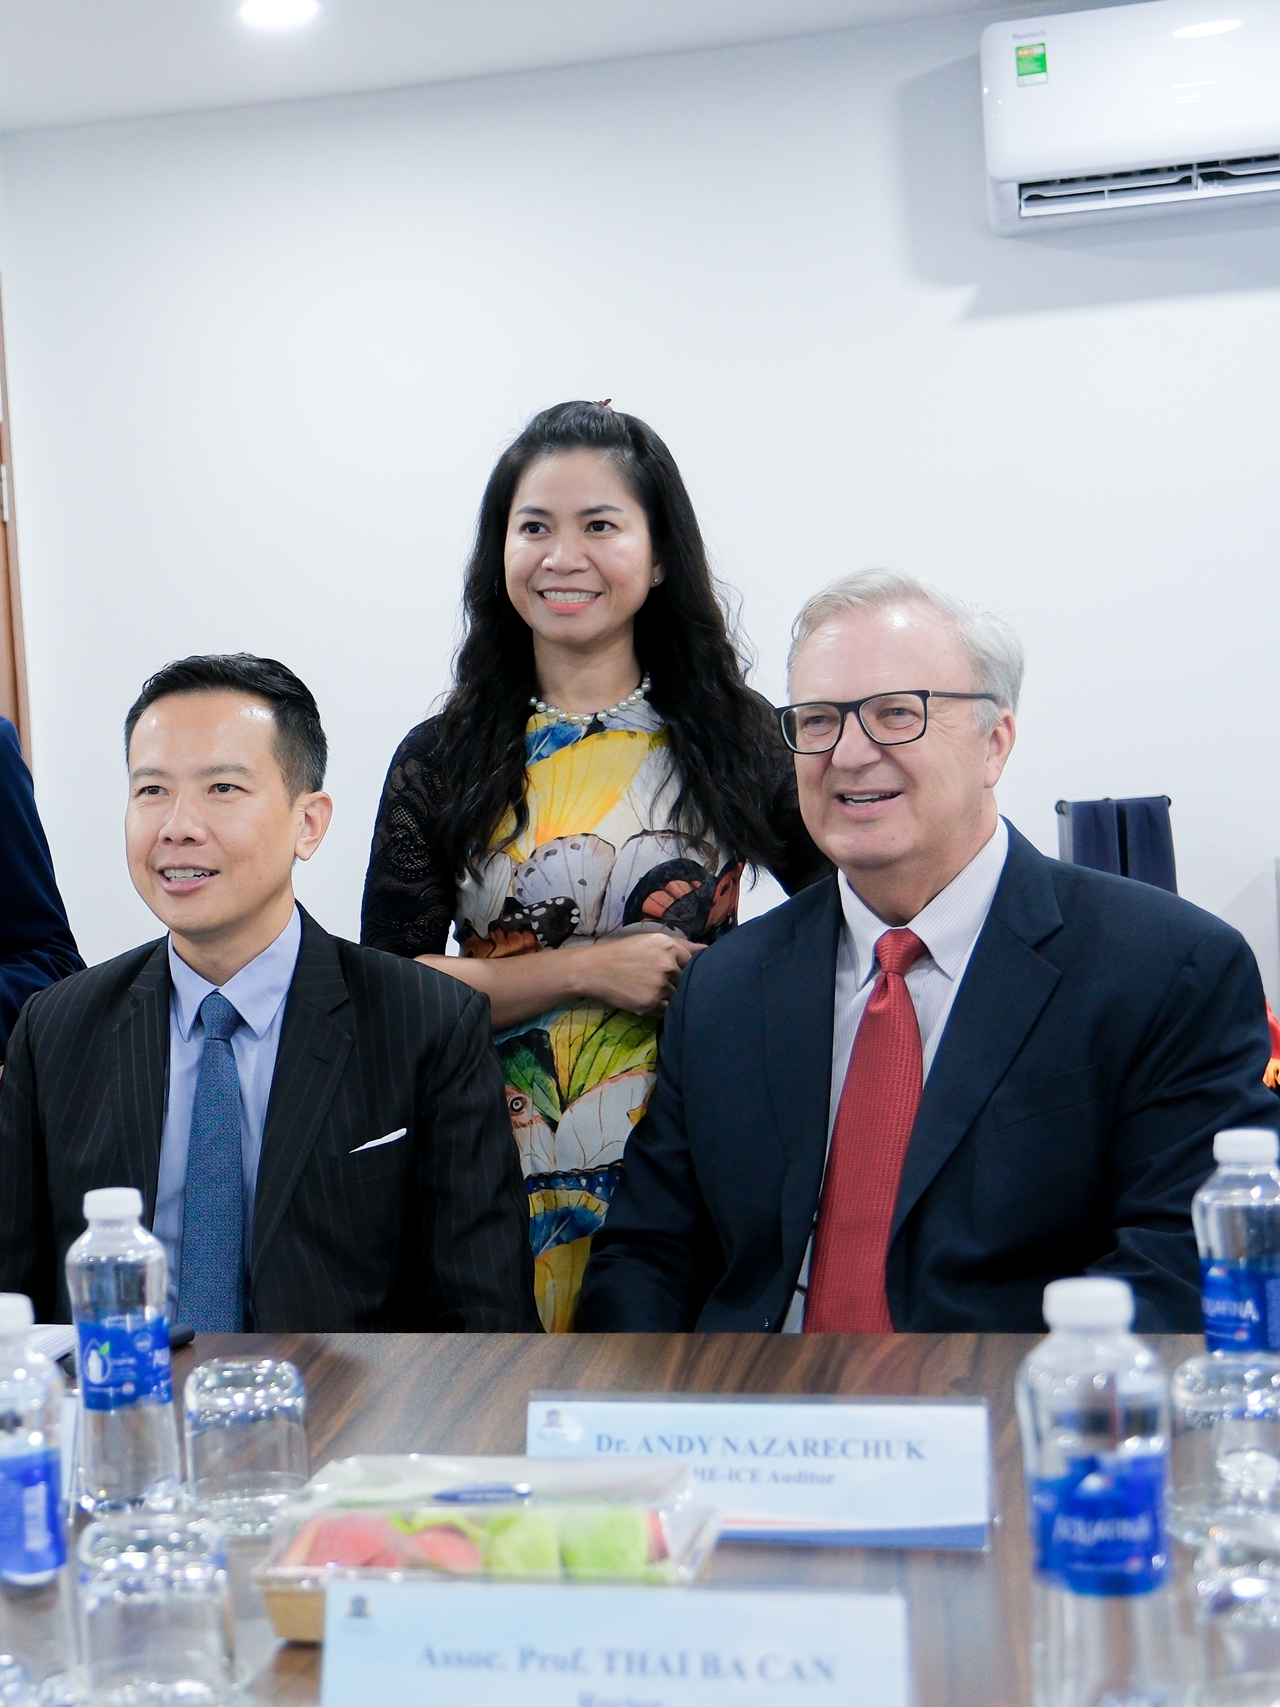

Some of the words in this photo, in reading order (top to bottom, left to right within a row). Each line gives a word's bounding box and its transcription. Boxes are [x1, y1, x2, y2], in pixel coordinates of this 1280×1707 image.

[595, 1433, 631, 1454] Dr.
[636, 1434, 715, 1456] ANDY
[721, 1435, 927, 1461] NAZARECHUK
[693, 1466, 761, 1484] HE-ICE
[767, 1468, 835, 1485] Auditor
[419, 1643, 506, 1672] Assoc.
[518, 1645, 589, 1675] Prof.
[602, 1647, 691, 1679] THAI
[700, 1651, 746, 1681] BA
[757, 1652, 836, 1683] CAN
